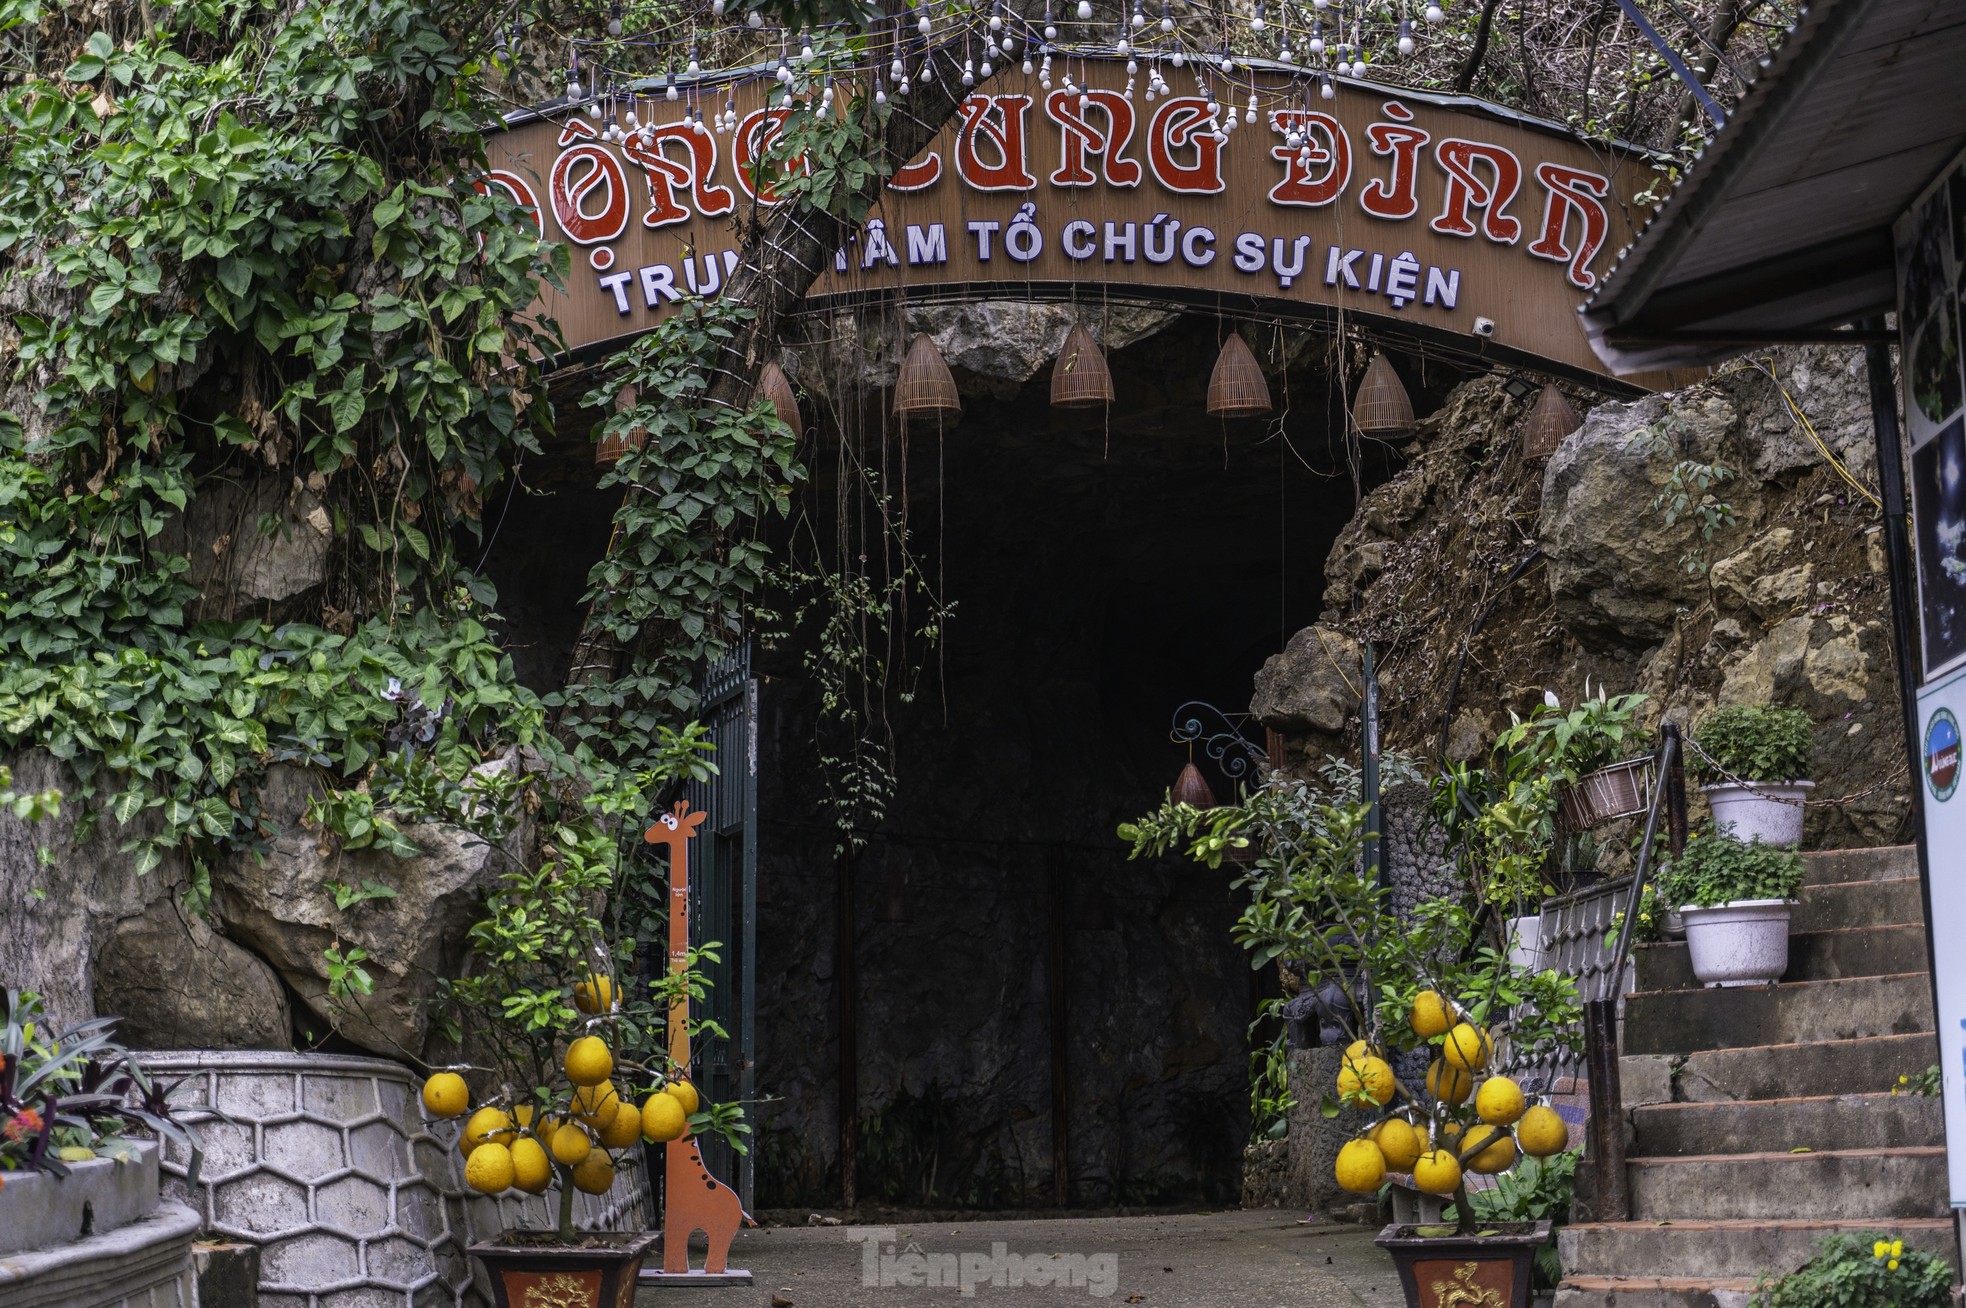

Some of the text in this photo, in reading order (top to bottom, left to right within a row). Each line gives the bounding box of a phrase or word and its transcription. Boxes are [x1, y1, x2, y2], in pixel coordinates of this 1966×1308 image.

[598, 249, 740, 315] TRU
[967, 203, 1044, 264] TỔ
[1061, 213, 1217, 267] CHỨC
[1233, 232, 1311, 289] SỰ
[1323, 244, 1461, 309] KIỆN
[1267, 100, 1611, 290] ĐÌNH
